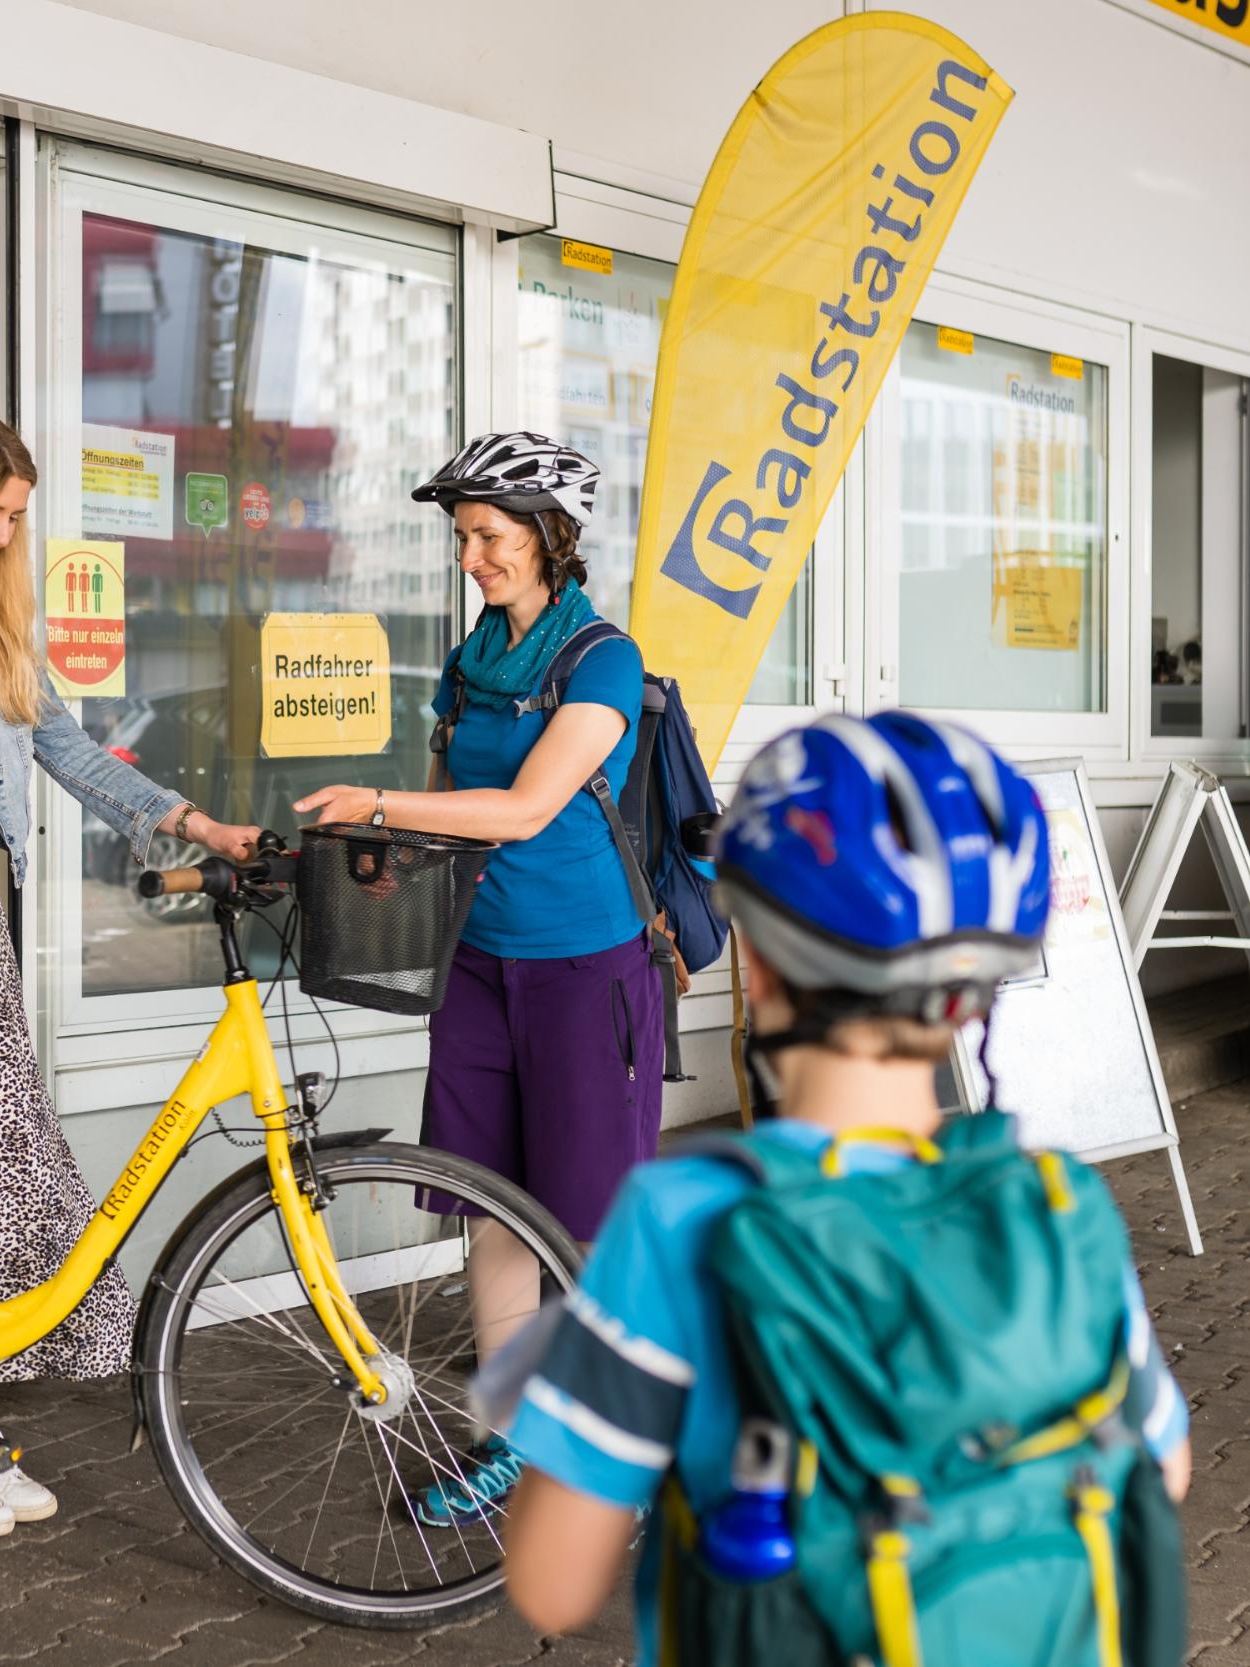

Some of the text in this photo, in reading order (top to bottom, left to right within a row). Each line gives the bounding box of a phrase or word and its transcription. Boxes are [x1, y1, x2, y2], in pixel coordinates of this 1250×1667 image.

[707, 59, 989, 574] Radstation
[1011, 381, 1075, 414] Radstation
[48, 627, 124, 644] Bitte nur einzeln
[66, 653, 107, 670] eintreten
[275, 654, 373, 679] Radfahrer
[274, 691, 376, 721] absteigen!
[106, 1100, 186, 1213] Radstation
